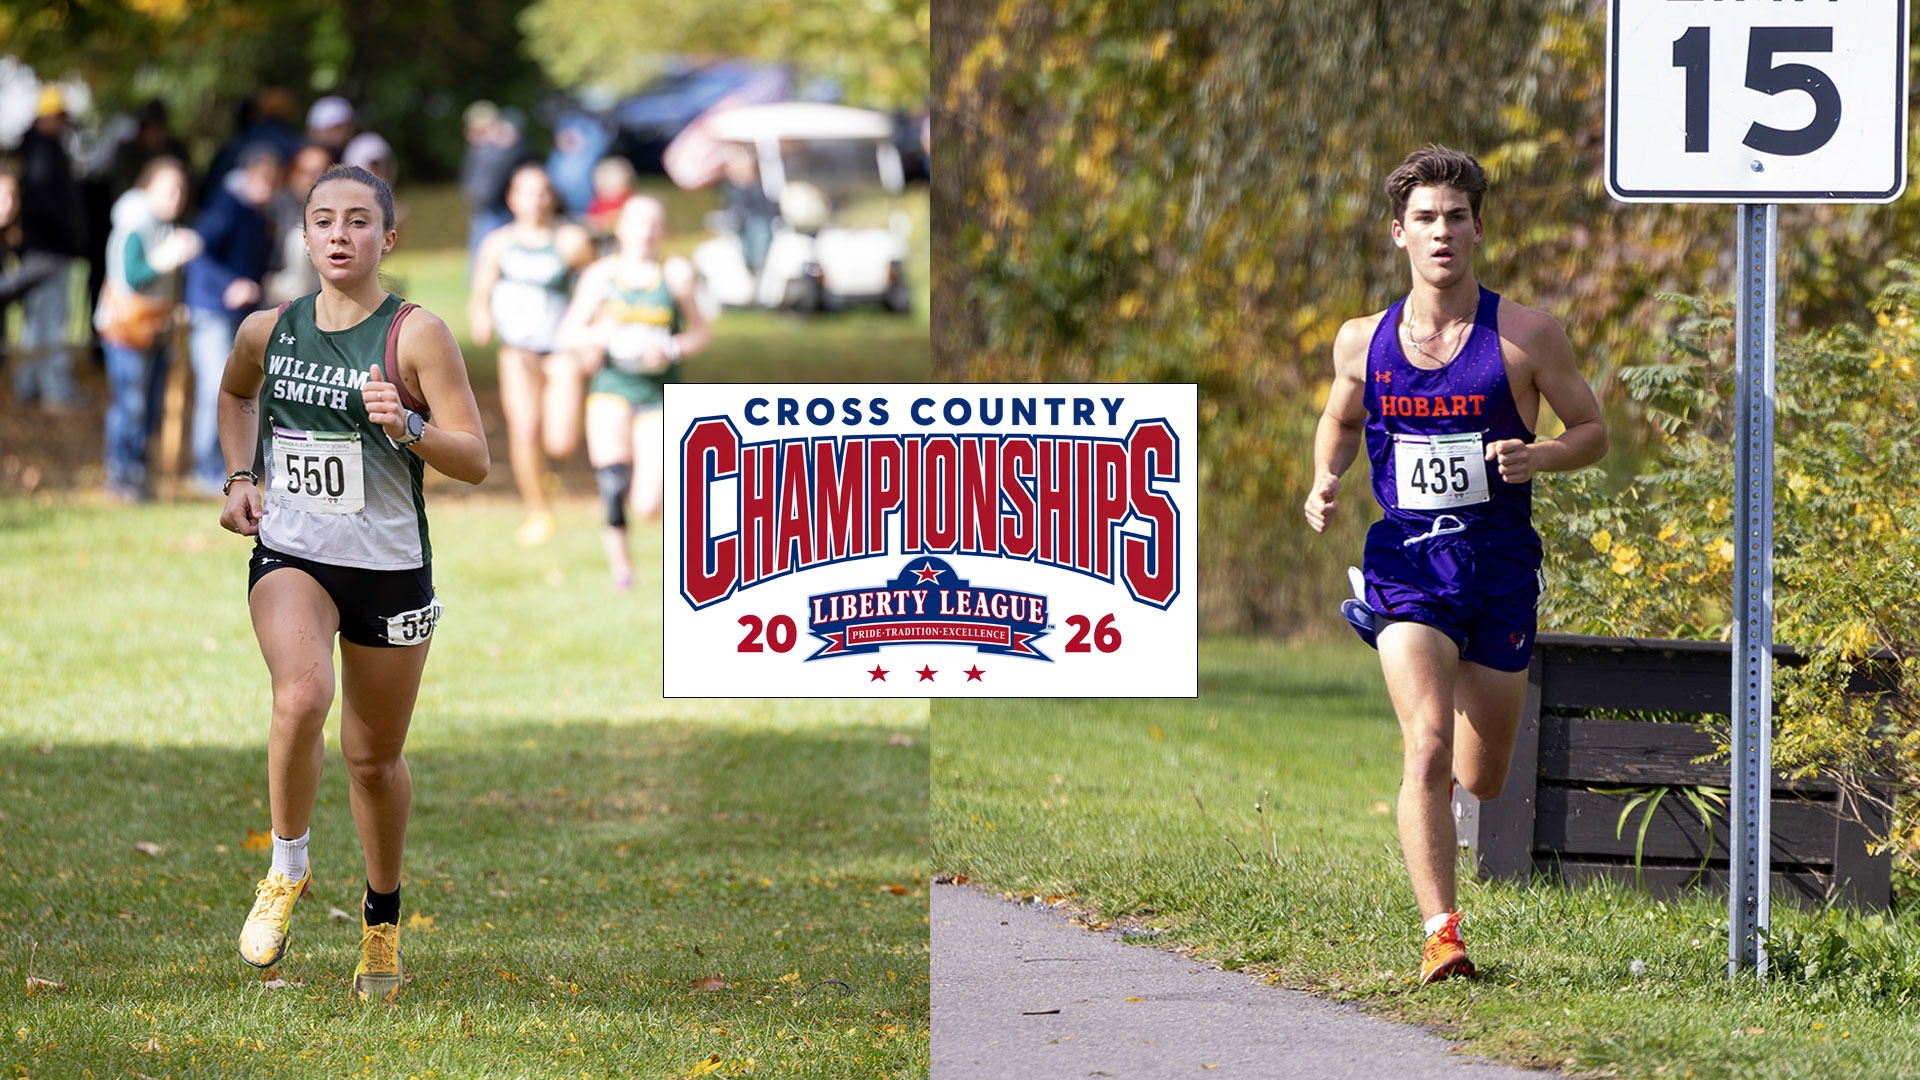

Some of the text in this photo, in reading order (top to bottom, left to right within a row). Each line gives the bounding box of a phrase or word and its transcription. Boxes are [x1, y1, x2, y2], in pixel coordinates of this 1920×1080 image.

[1672, 26, 1842, 157] 15
[268, 355, 370, 391] WILLIAM
[273, 379, 349, 411] SMITH
[1380, 395, 1485, 417] HOBART
[286, 454, 345, 497] 550
[1411, 456, 1470, 494] 435
